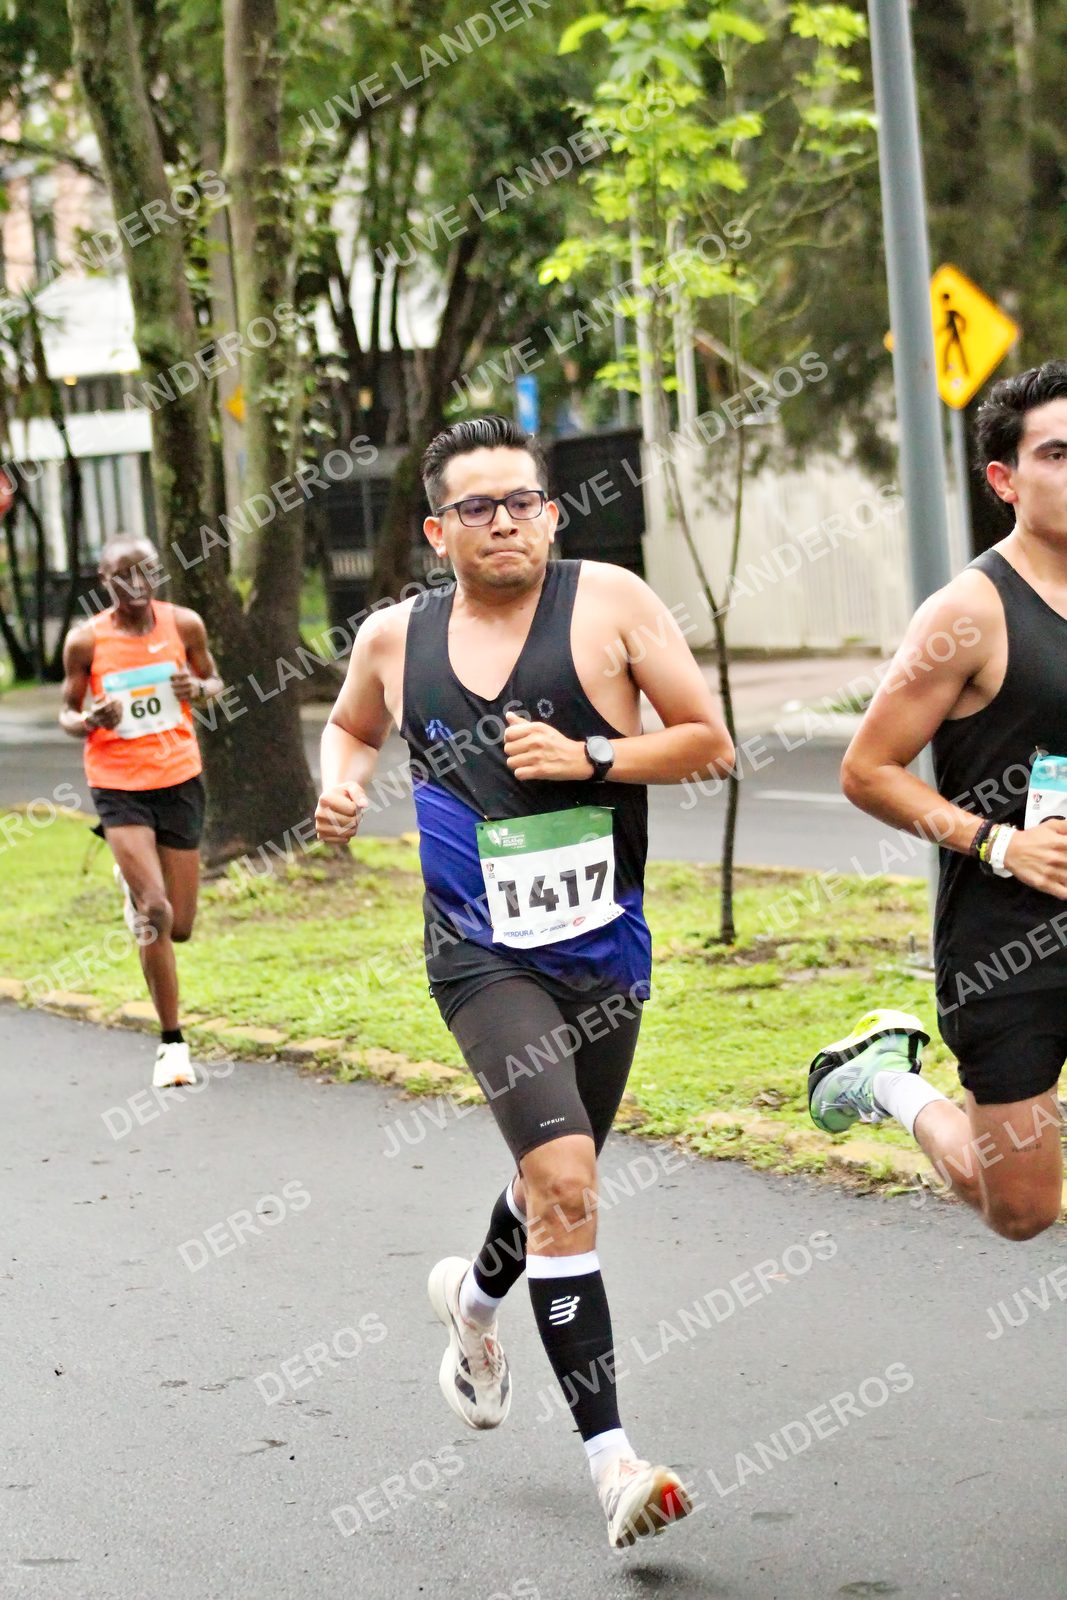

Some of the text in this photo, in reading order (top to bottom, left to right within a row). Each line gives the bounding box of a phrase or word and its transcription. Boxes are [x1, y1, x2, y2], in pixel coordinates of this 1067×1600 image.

[131, 697, 161, 718] 60
[498, 860, 608, 918] 1417
[503, 929, 534, 938] PERDURA
